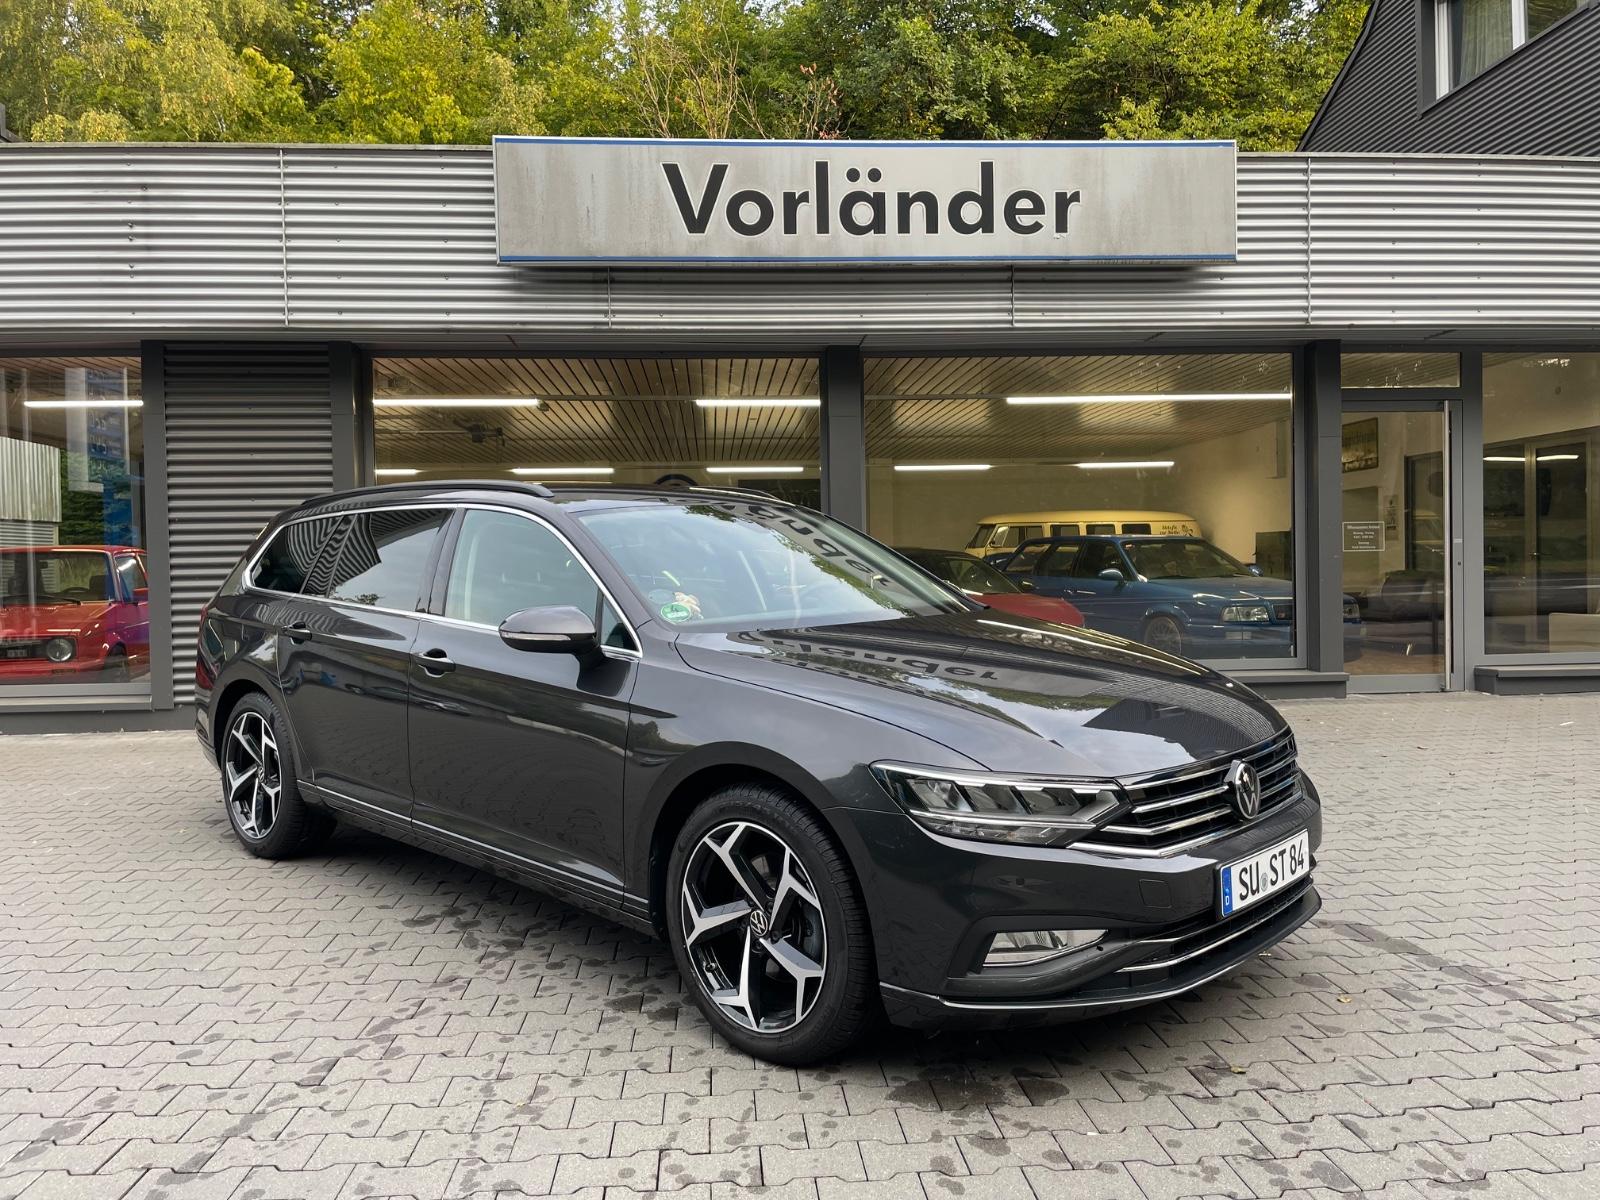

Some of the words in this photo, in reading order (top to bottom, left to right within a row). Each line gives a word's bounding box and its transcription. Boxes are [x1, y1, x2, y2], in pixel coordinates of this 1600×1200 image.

[662, 160, 1081, 236] Vorländer
[1239, 861, 1260, 901] SU
[1269, 848, 1287, 886] ST
[1289, 839, 1304, 875] 84
